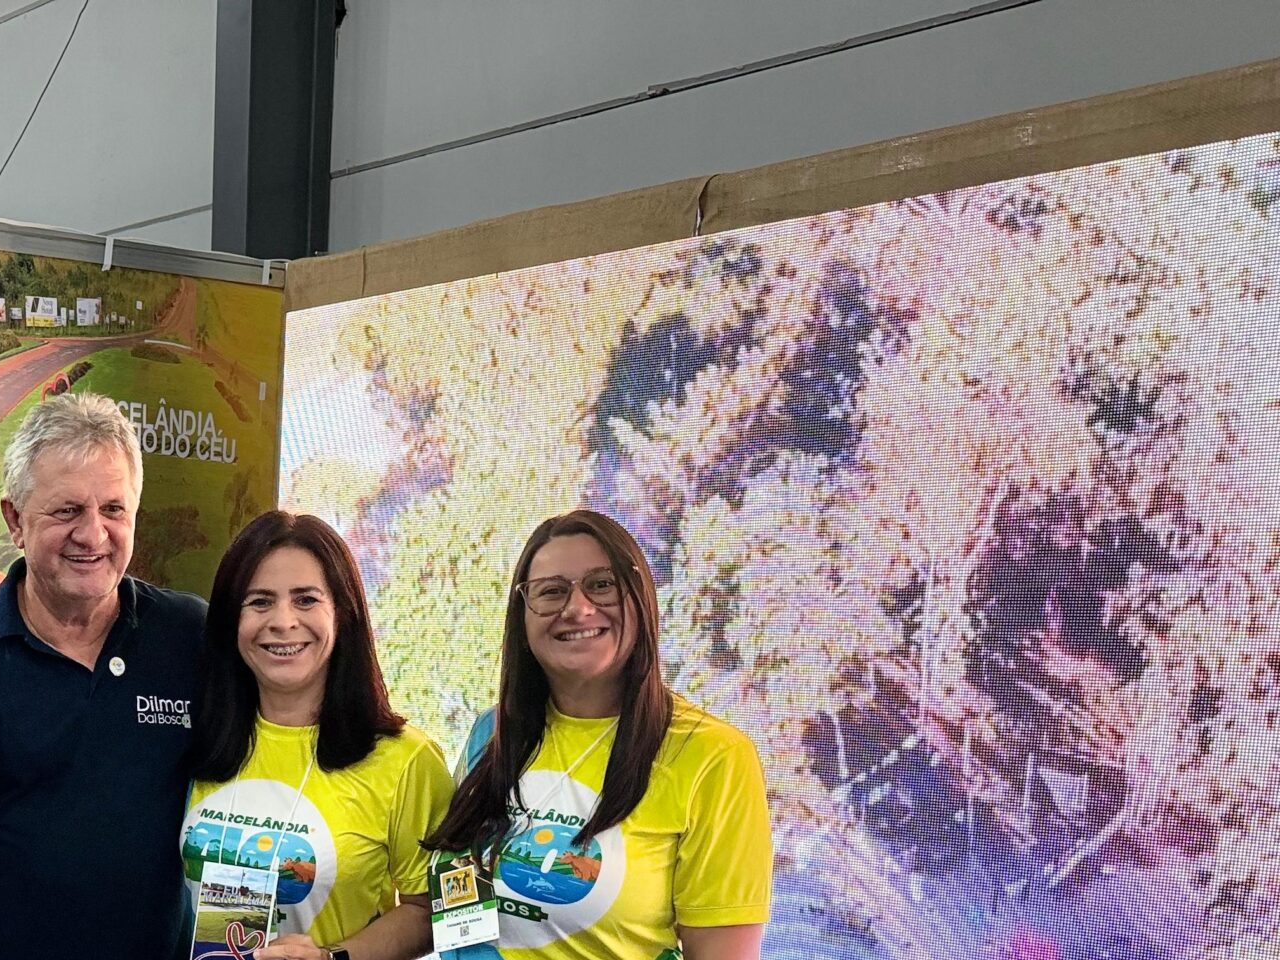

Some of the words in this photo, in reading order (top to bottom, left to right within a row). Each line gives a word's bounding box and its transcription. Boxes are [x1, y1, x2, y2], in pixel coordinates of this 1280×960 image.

[161, 430, 191, 459] DO
[196, 429, 237, 464] CÉU
[136, 695, 191, 713] Dilmar
[137, 712, 157, 724] Dal
[200, 808, 309, 835] MARCELÂNDIA
